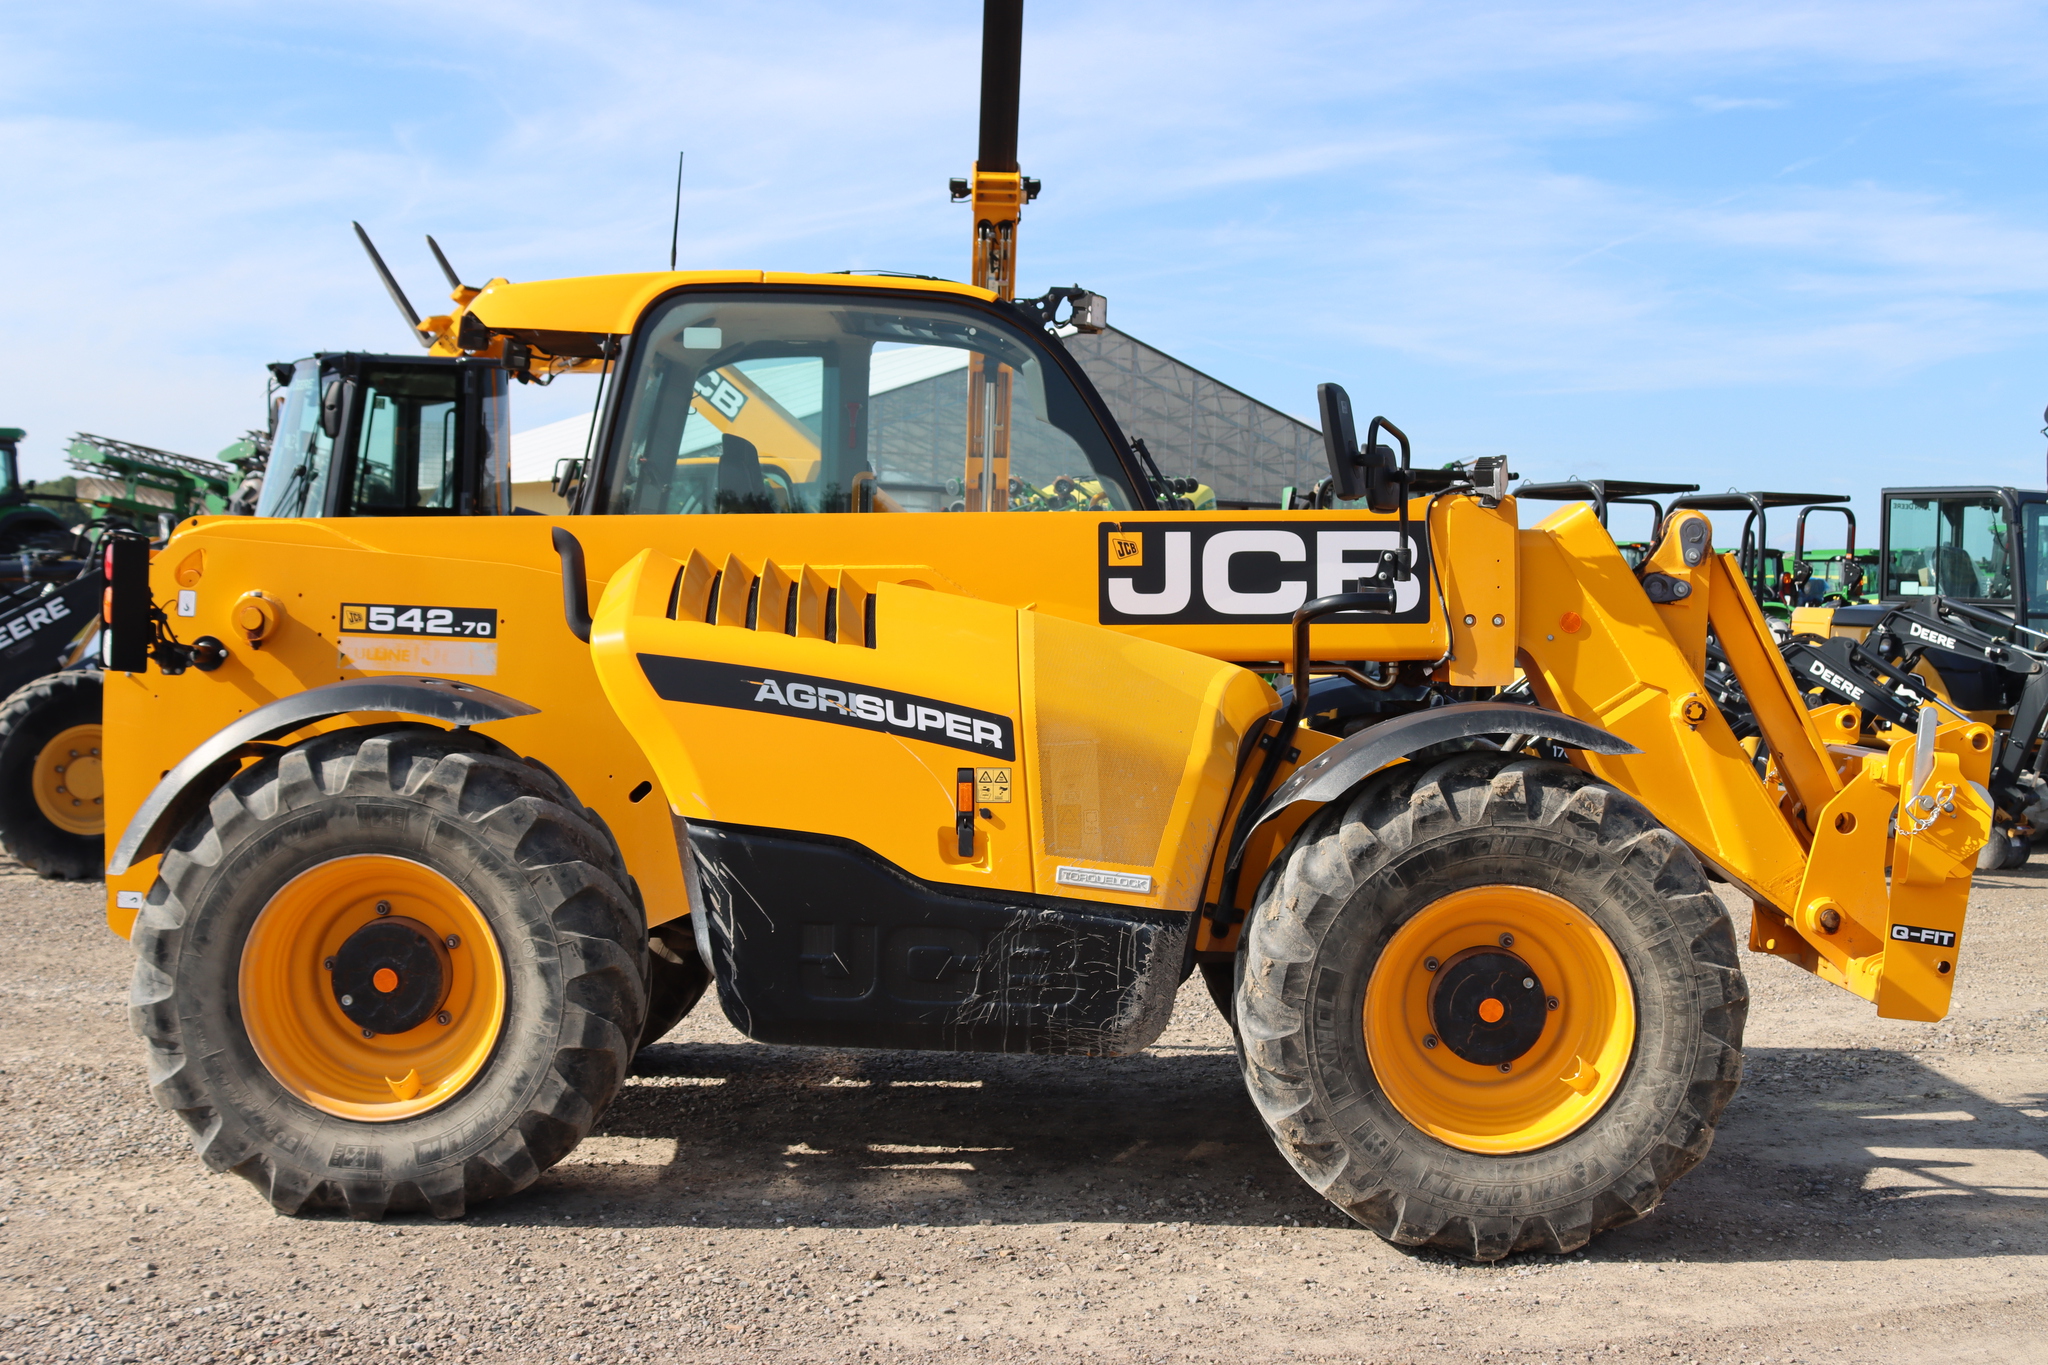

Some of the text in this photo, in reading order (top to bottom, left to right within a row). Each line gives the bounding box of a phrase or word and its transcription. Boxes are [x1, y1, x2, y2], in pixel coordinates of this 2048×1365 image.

[1117, 541, 1137, 557] JCB
[1108, 530, 1421, 615] JCB
[1910, 622, 1957, 650] DEERE
[1809, 659, 1865, 701] DEERE
[754, 678, 1003, 749] AGRISUPER
[1063, 871, 1148, 890] TORQUELOCK
[1892, 925, 1954, 945] Q-FIT
[800, 923, 1079, 1006] JCB
